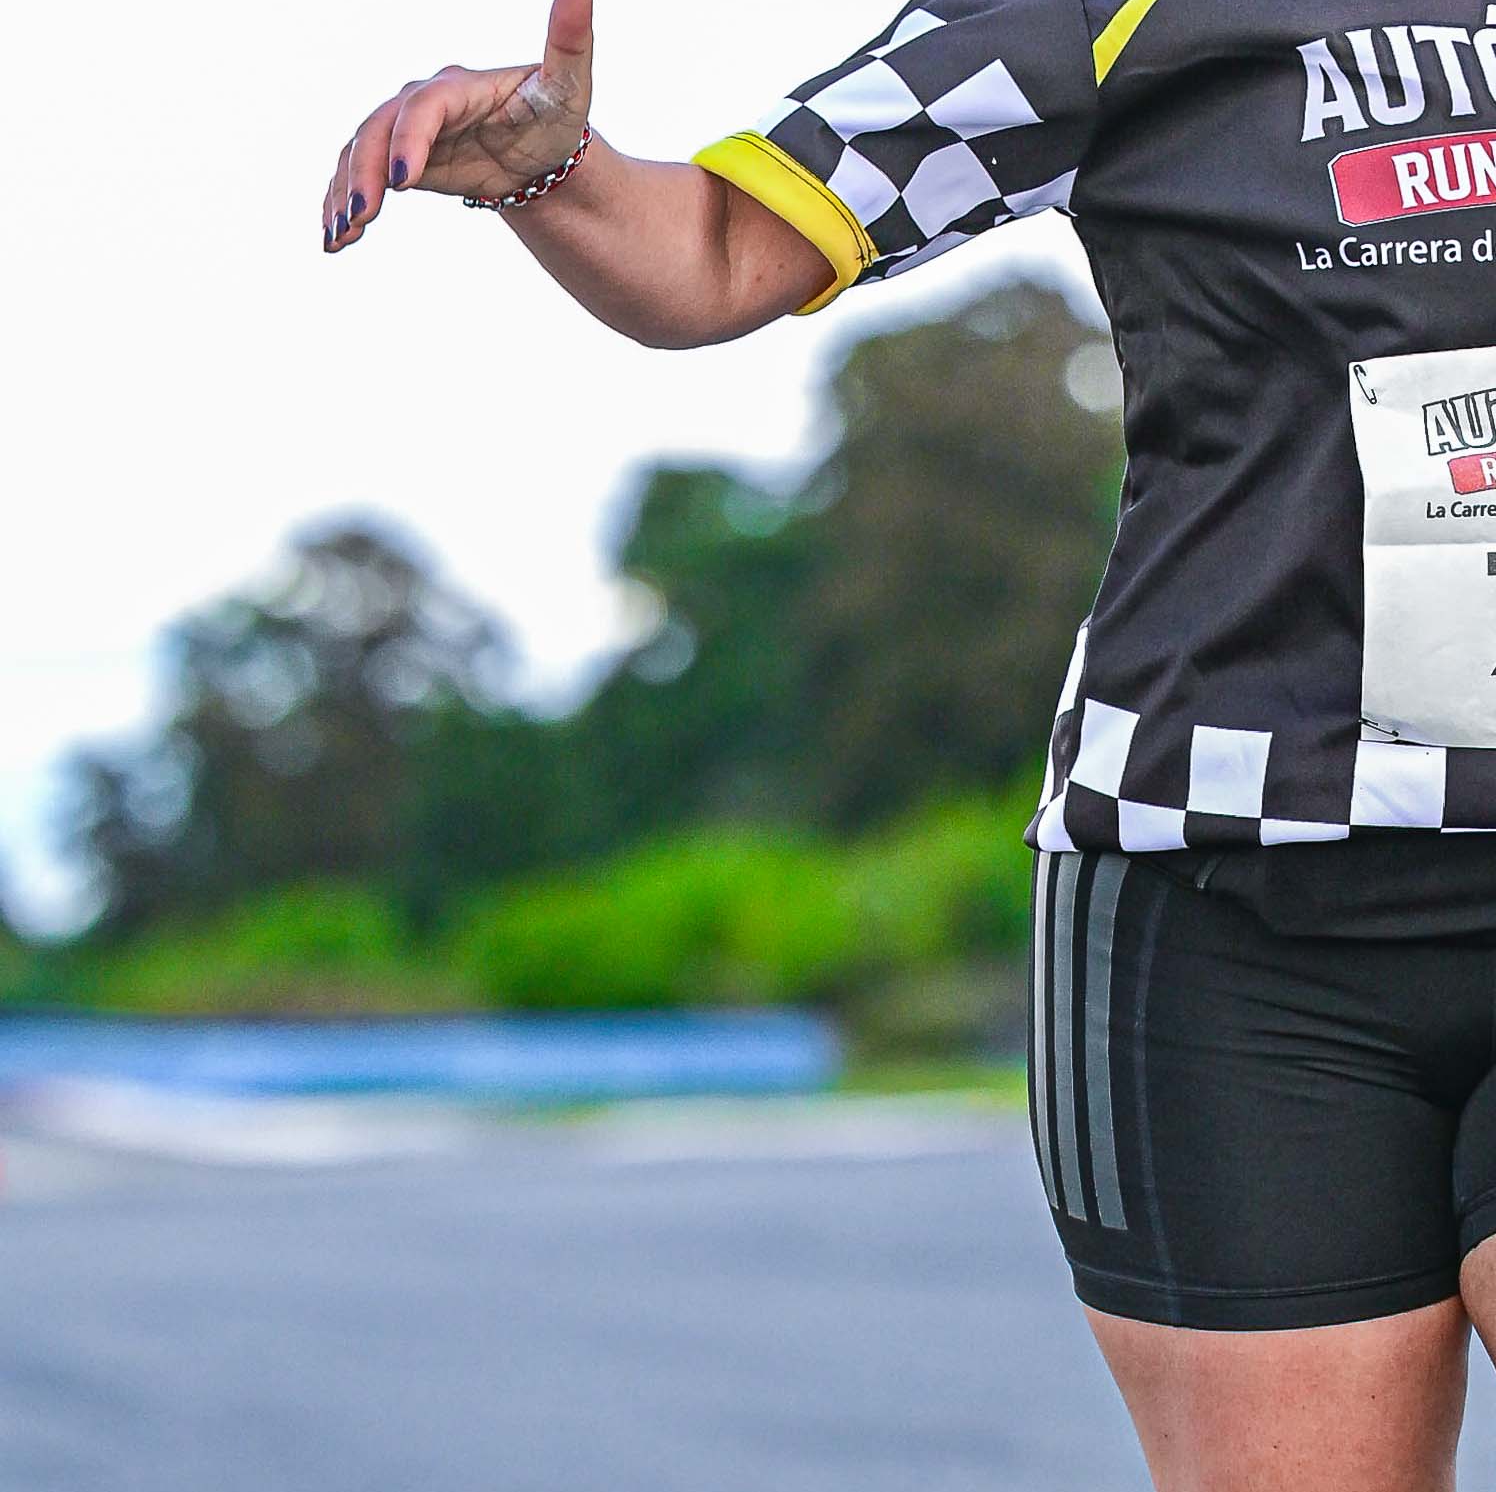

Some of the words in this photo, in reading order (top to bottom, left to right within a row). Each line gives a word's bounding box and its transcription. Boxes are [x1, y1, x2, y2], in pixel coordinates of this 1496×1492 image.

[1296, 242, 1334, 271] La
[1338, 237, 1463, 268] Carrera
[1426, 501, 1447, 519] La
